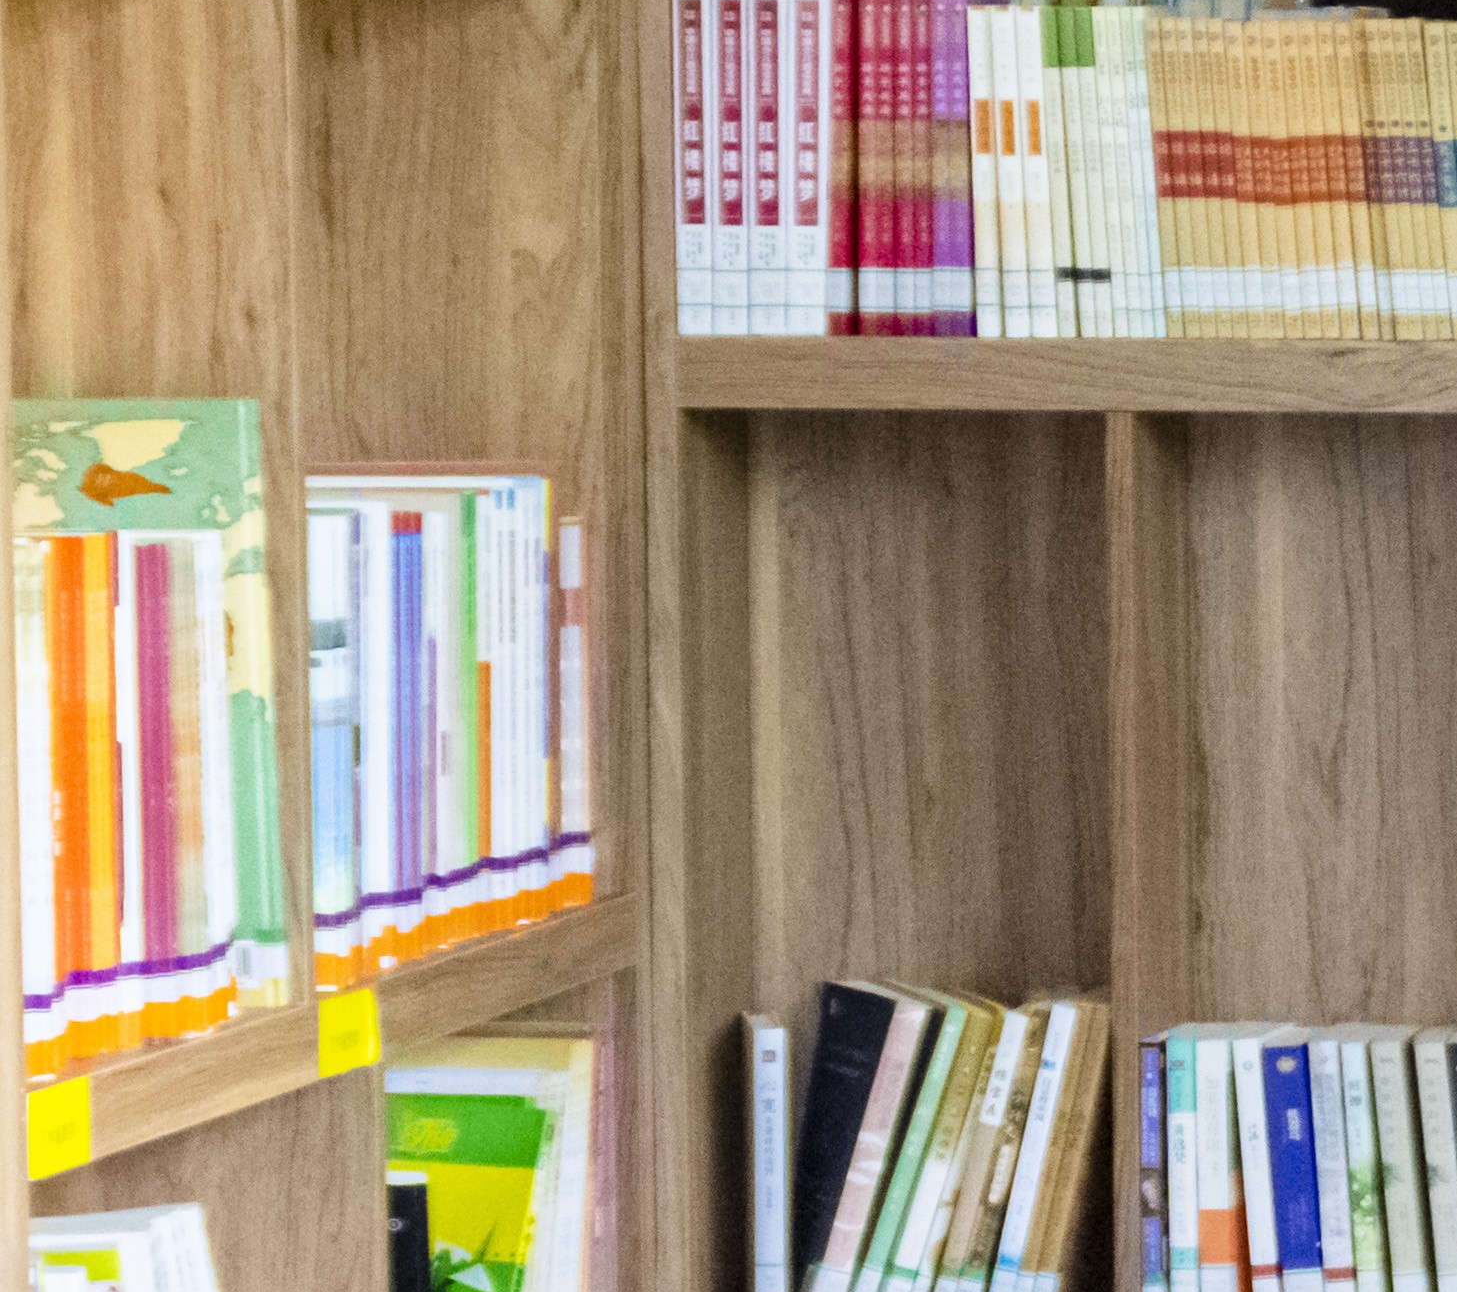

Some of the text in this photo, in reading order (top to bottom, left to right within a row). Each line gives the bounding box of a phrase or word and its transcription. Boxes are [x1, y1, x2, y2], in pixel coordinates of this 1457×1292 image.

[683, 120, 700, 201] 红楼梦
[722, 120, 740, 201] 红楼梦
[759, 120, 777, 202] 红楼梦
[798, 120, 815, 201] 红楼梦
